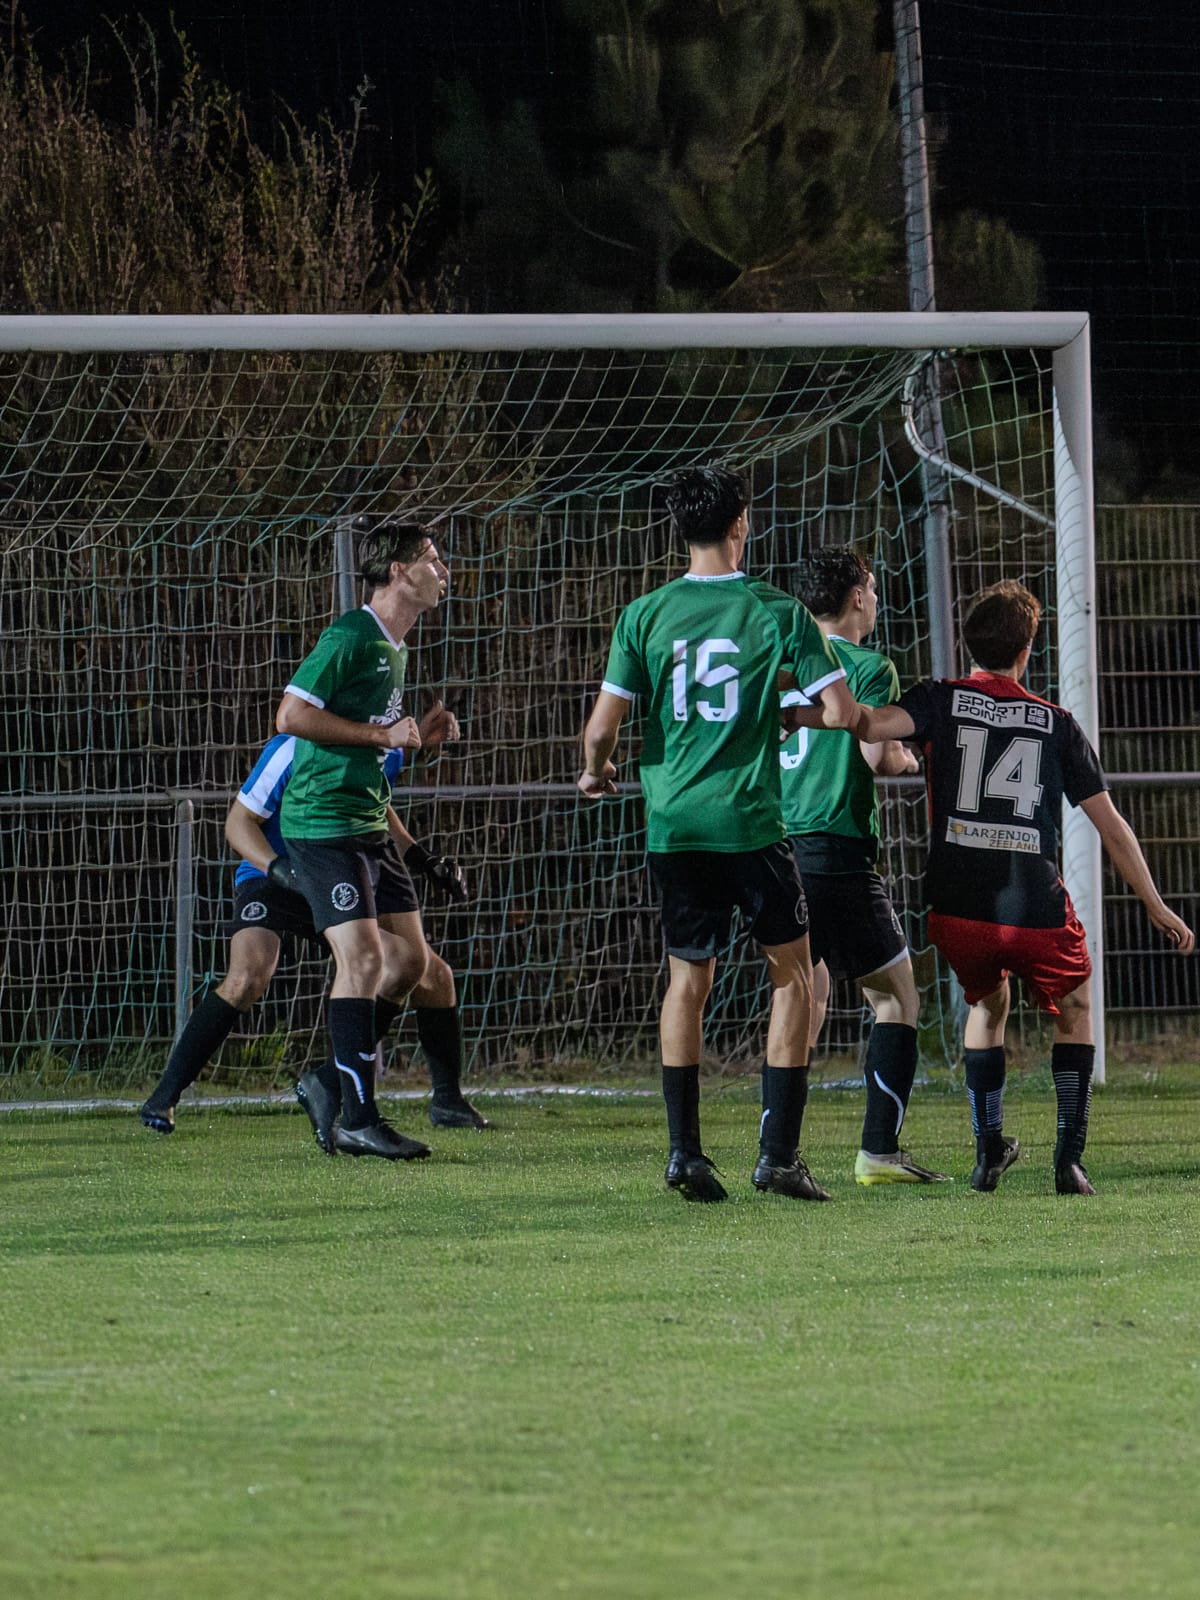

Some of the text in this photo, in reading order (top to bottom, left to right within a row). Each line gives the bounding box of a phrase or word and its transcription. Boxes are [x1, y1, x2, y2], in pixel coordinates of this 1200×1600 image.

[672, 638, 740, 721] 15
[957, 704, 1007, 723] POINT
[958, 694, 1022, 715] SPORT
[956, 725, 1044, 820] 14
[989, 839, 1038, 852] ZEELAND
